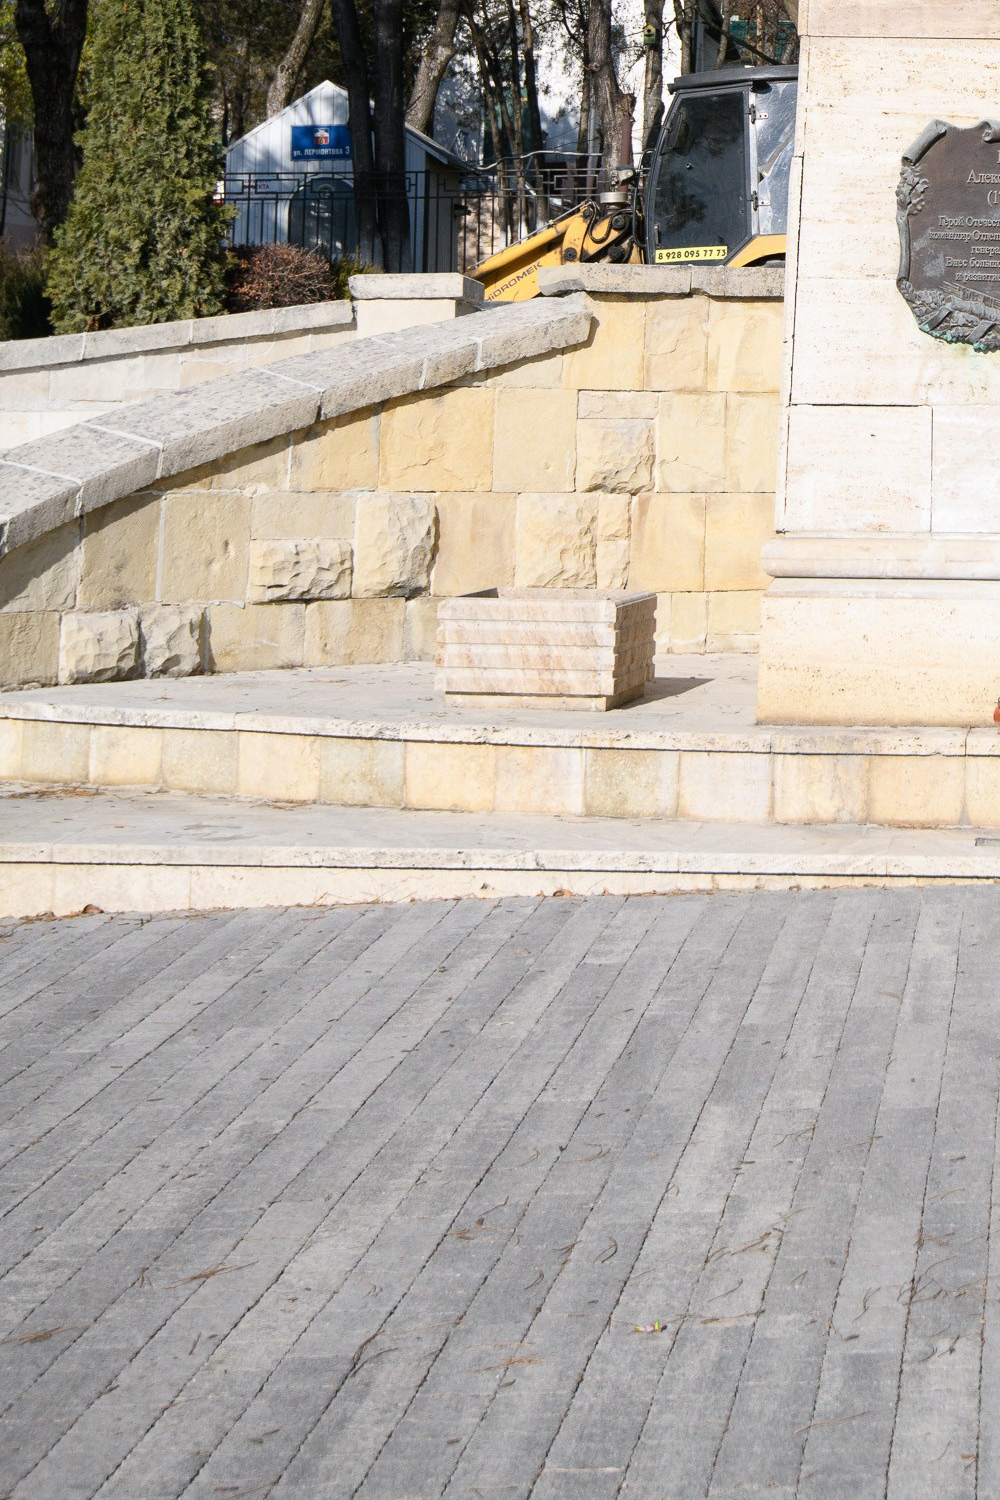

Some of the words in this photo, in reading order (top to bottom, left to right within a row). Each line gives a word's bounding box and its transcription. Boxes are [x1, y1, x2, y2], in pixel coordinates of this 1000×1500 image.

[304, 148, 343, 156] ЛЕРМОНТОВА
[938, 215, 964, 229] Герой
[929, 231, 971, 243] командир
[666, 251, 682, 259] 928
[684, 250, 700, 258] 095
[703, 249, 713, 257] 77
[945, 257, 968, 267] Внес
[955, 273, 962, 281] и
